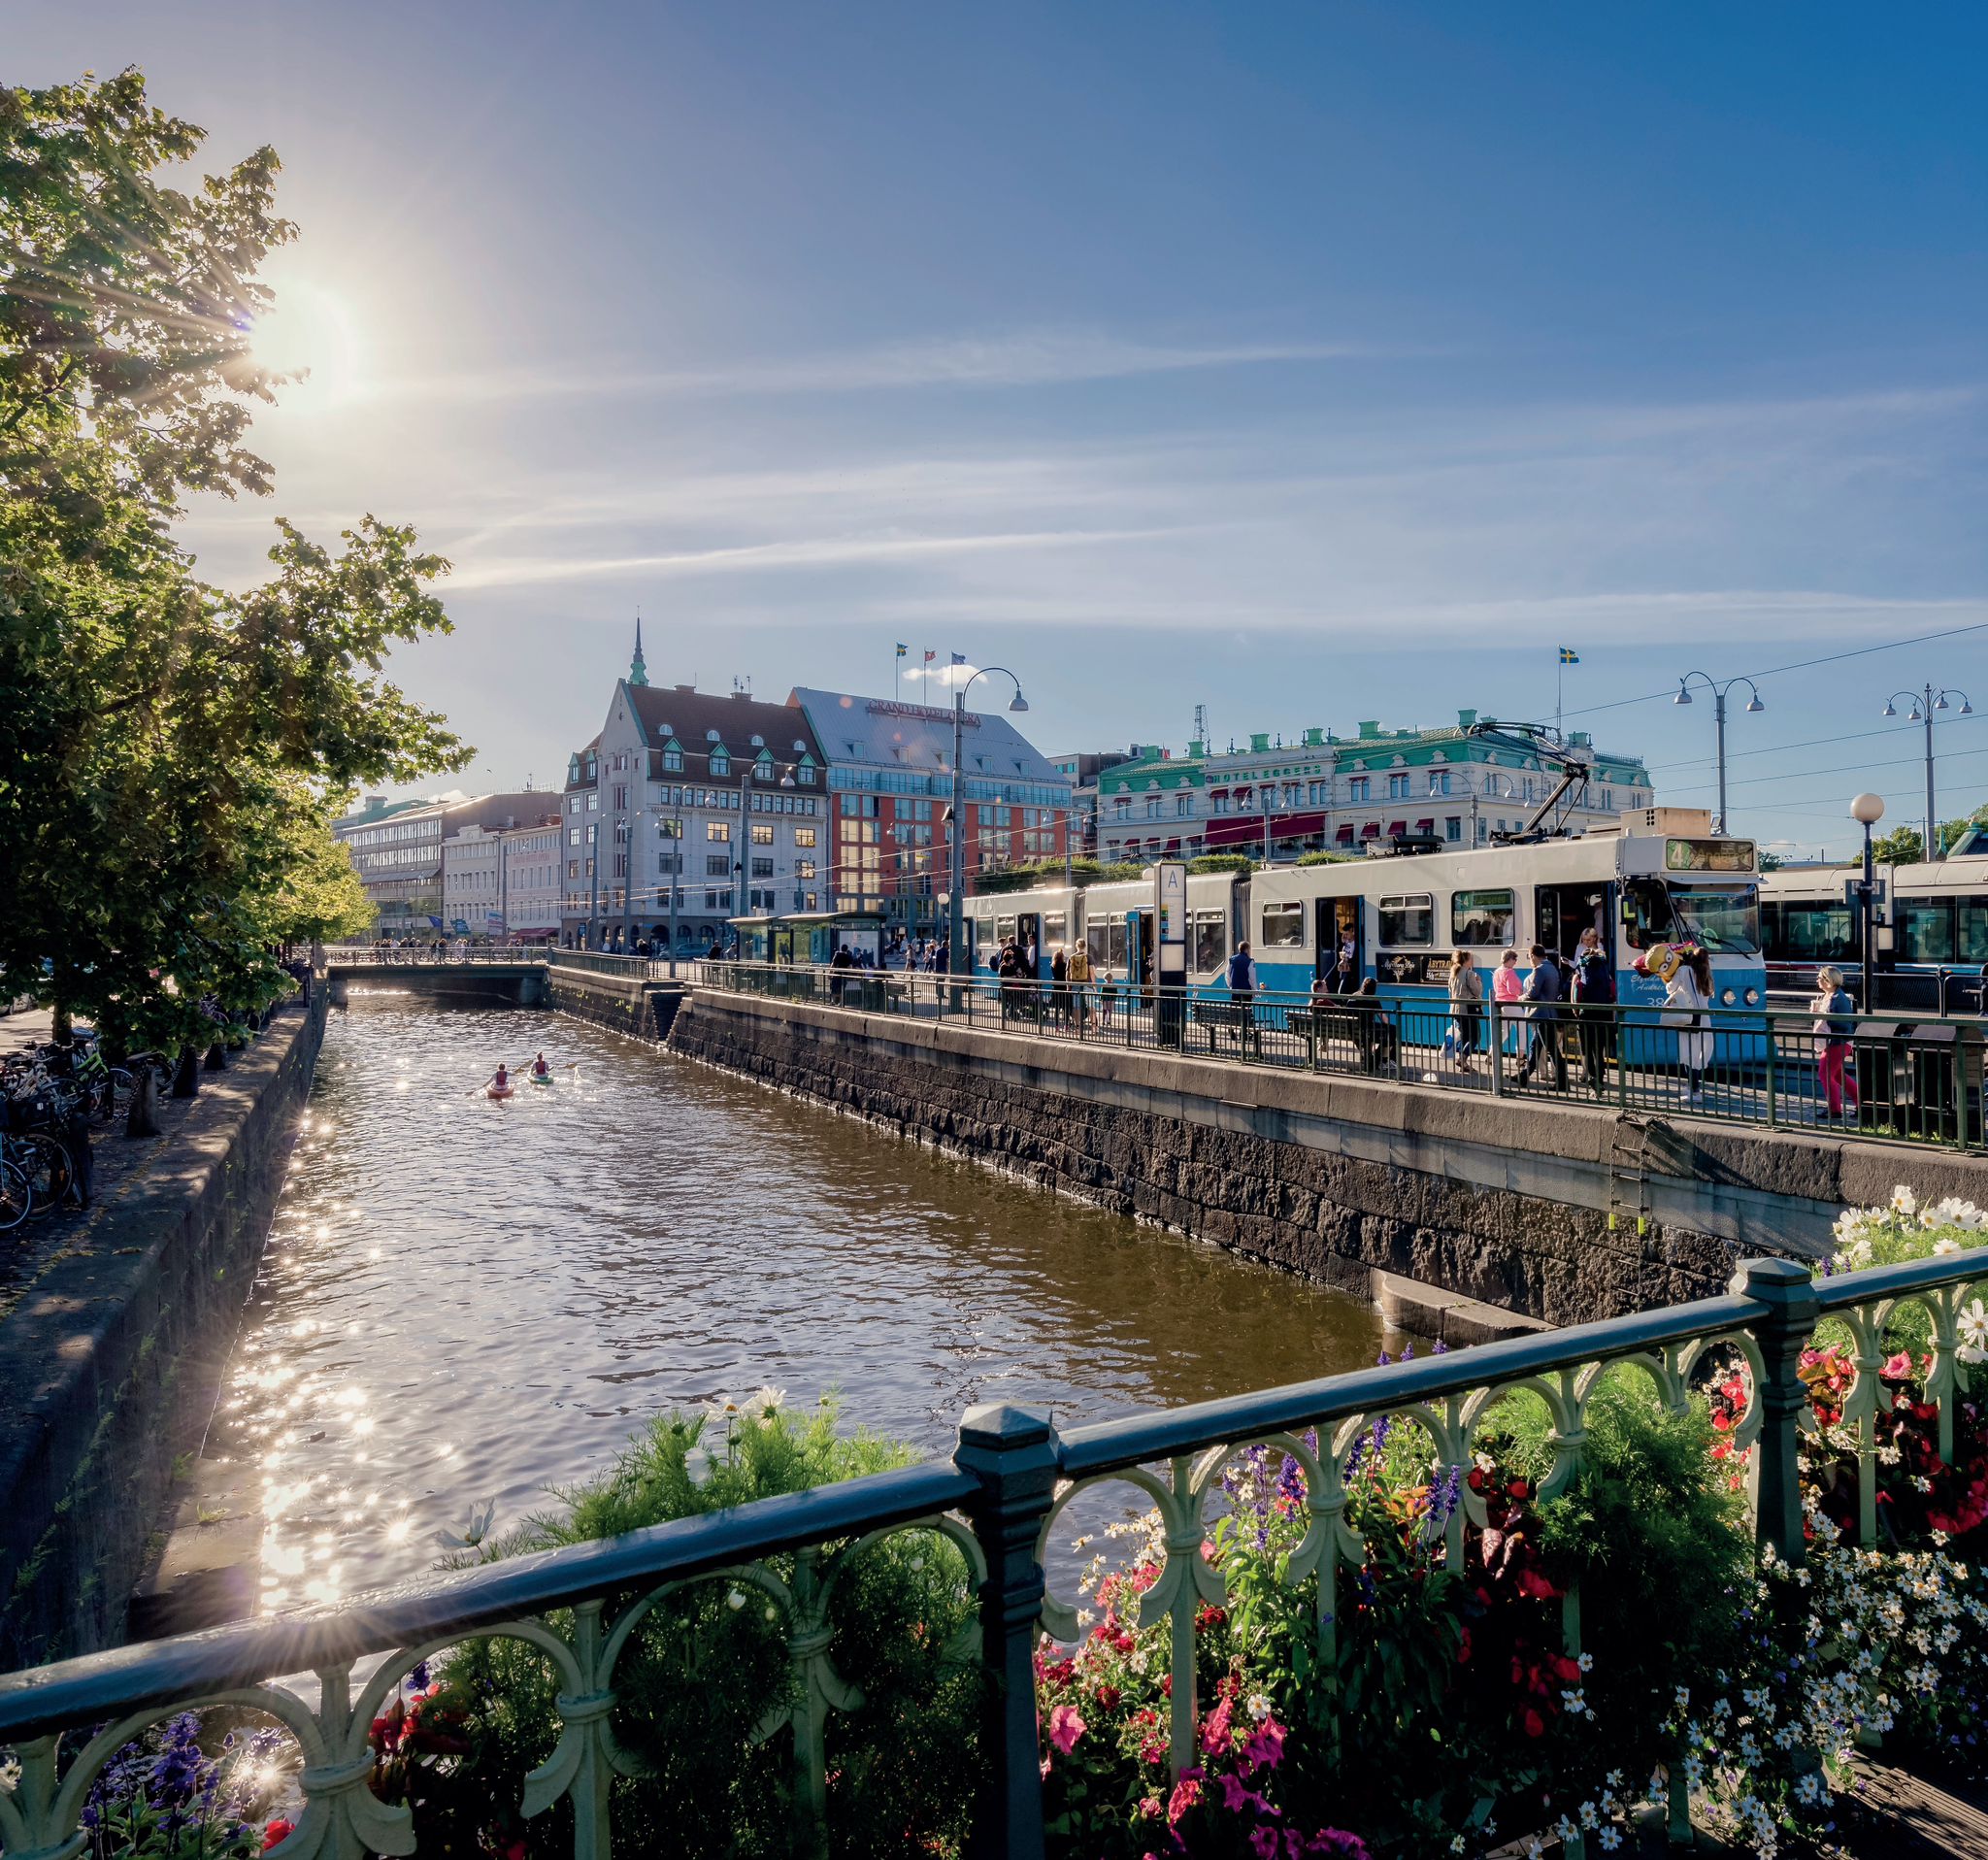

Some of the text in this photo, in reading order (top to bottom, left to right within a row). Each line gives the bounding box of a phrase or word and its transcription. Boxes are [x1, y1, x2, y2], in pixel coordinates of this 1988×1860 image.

[869, 699, 910, 715] GRAND
[947, 710, 981, 724] OERA
[1212, 764, 1321, 783] HOTEL EGGERS
[1671, 840, 1684, 867] 4
[1168, 870, 1177, 888] A
